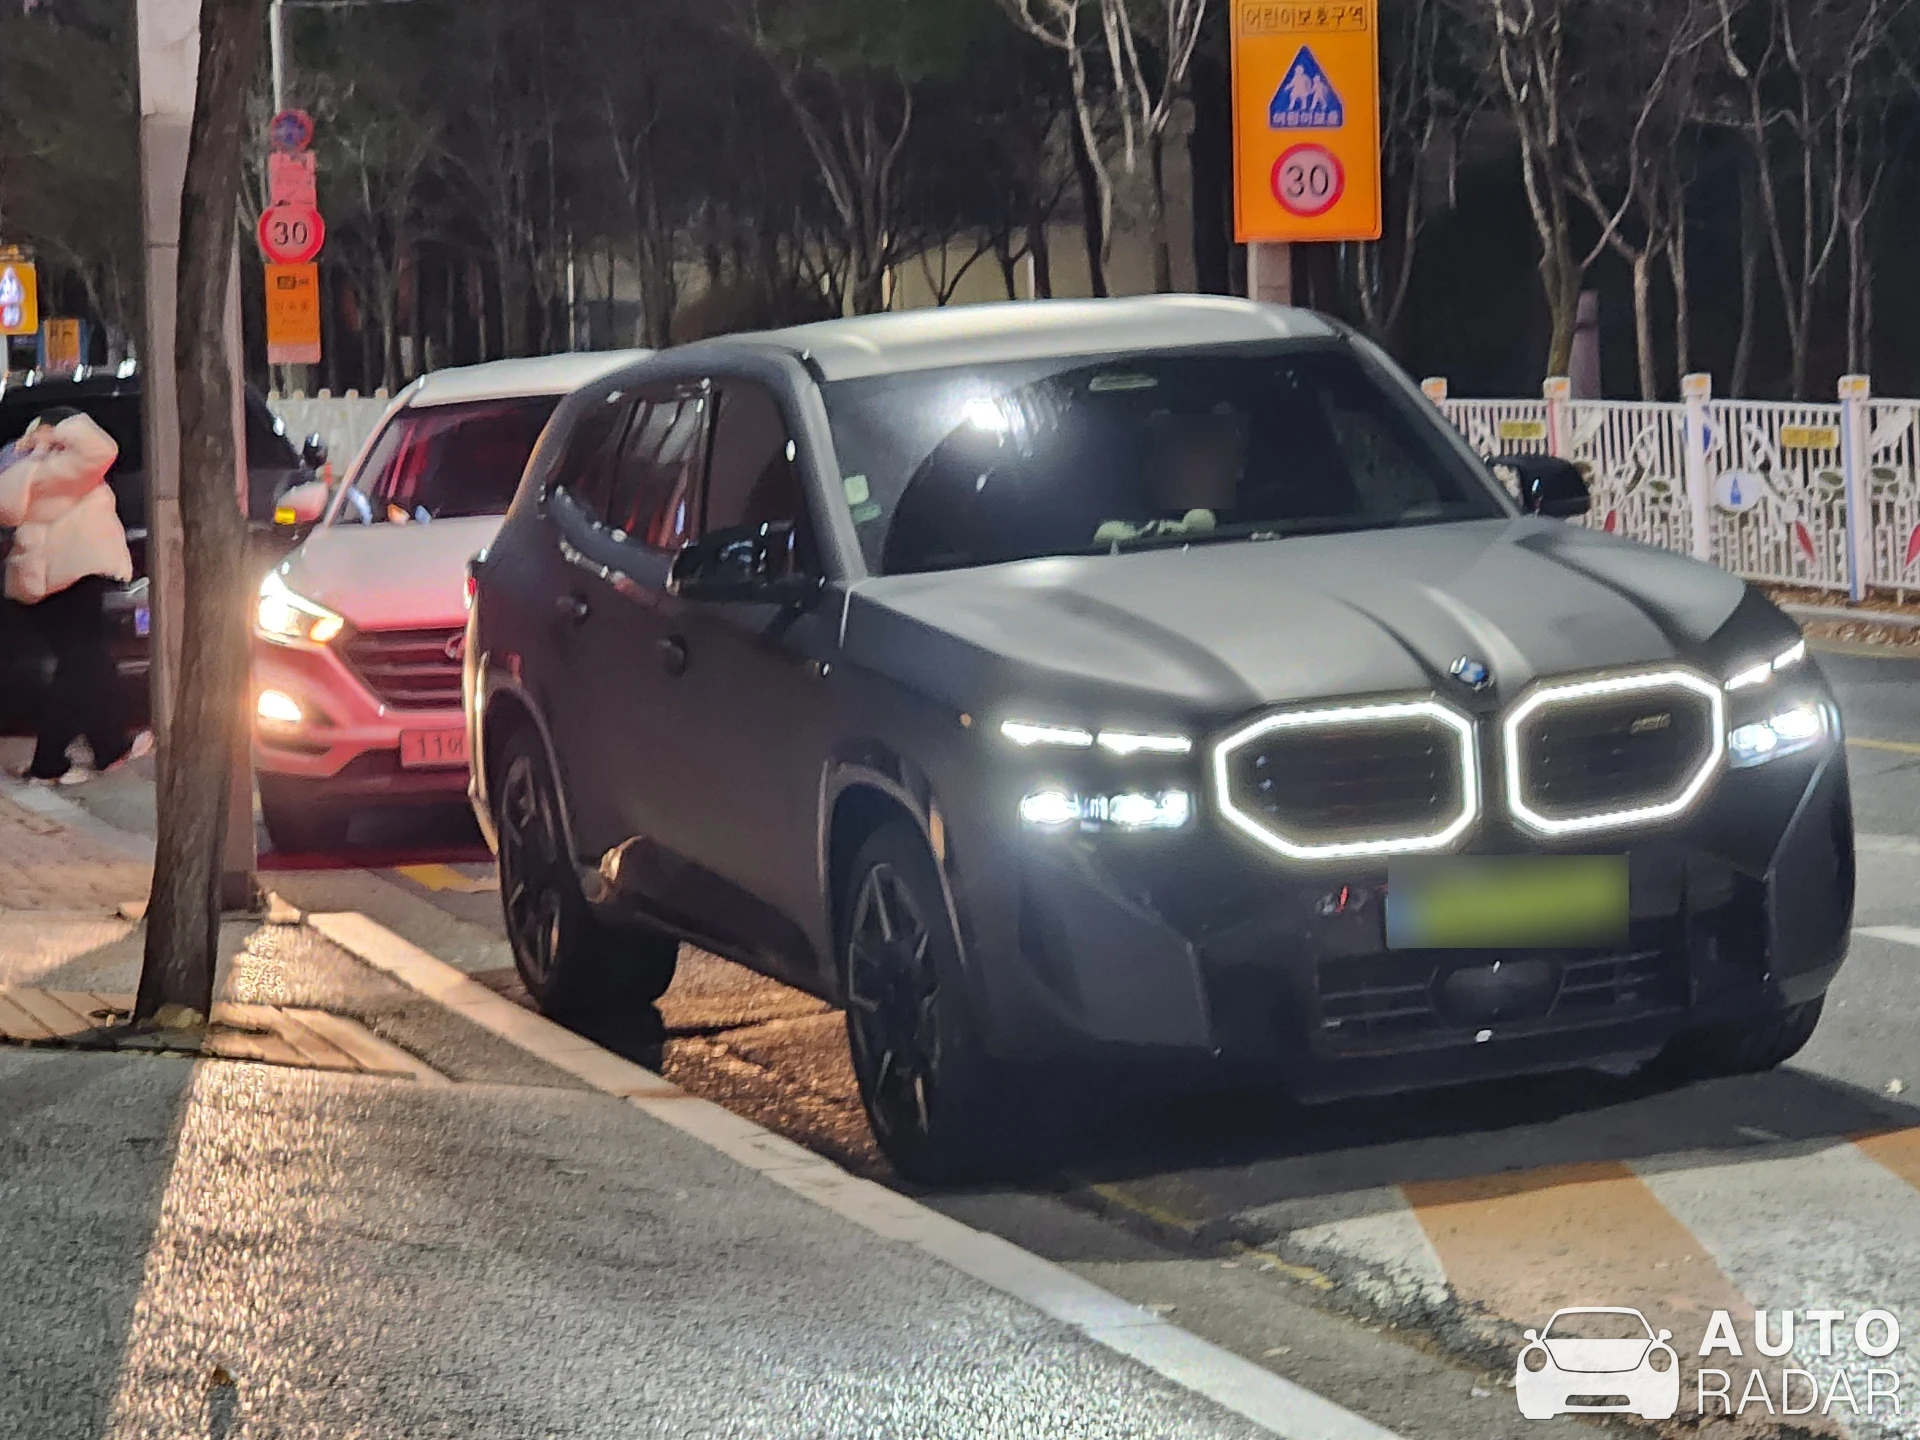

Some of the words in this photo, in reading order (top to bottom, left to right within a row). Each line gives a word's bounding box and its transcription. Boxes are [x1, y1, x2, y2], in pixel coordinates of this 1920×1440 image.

[1246, 6, 1364, 30] 어린이보호구역
[1286, 165, 1329, 198] 30
[273, 221, 308, 246] 30
